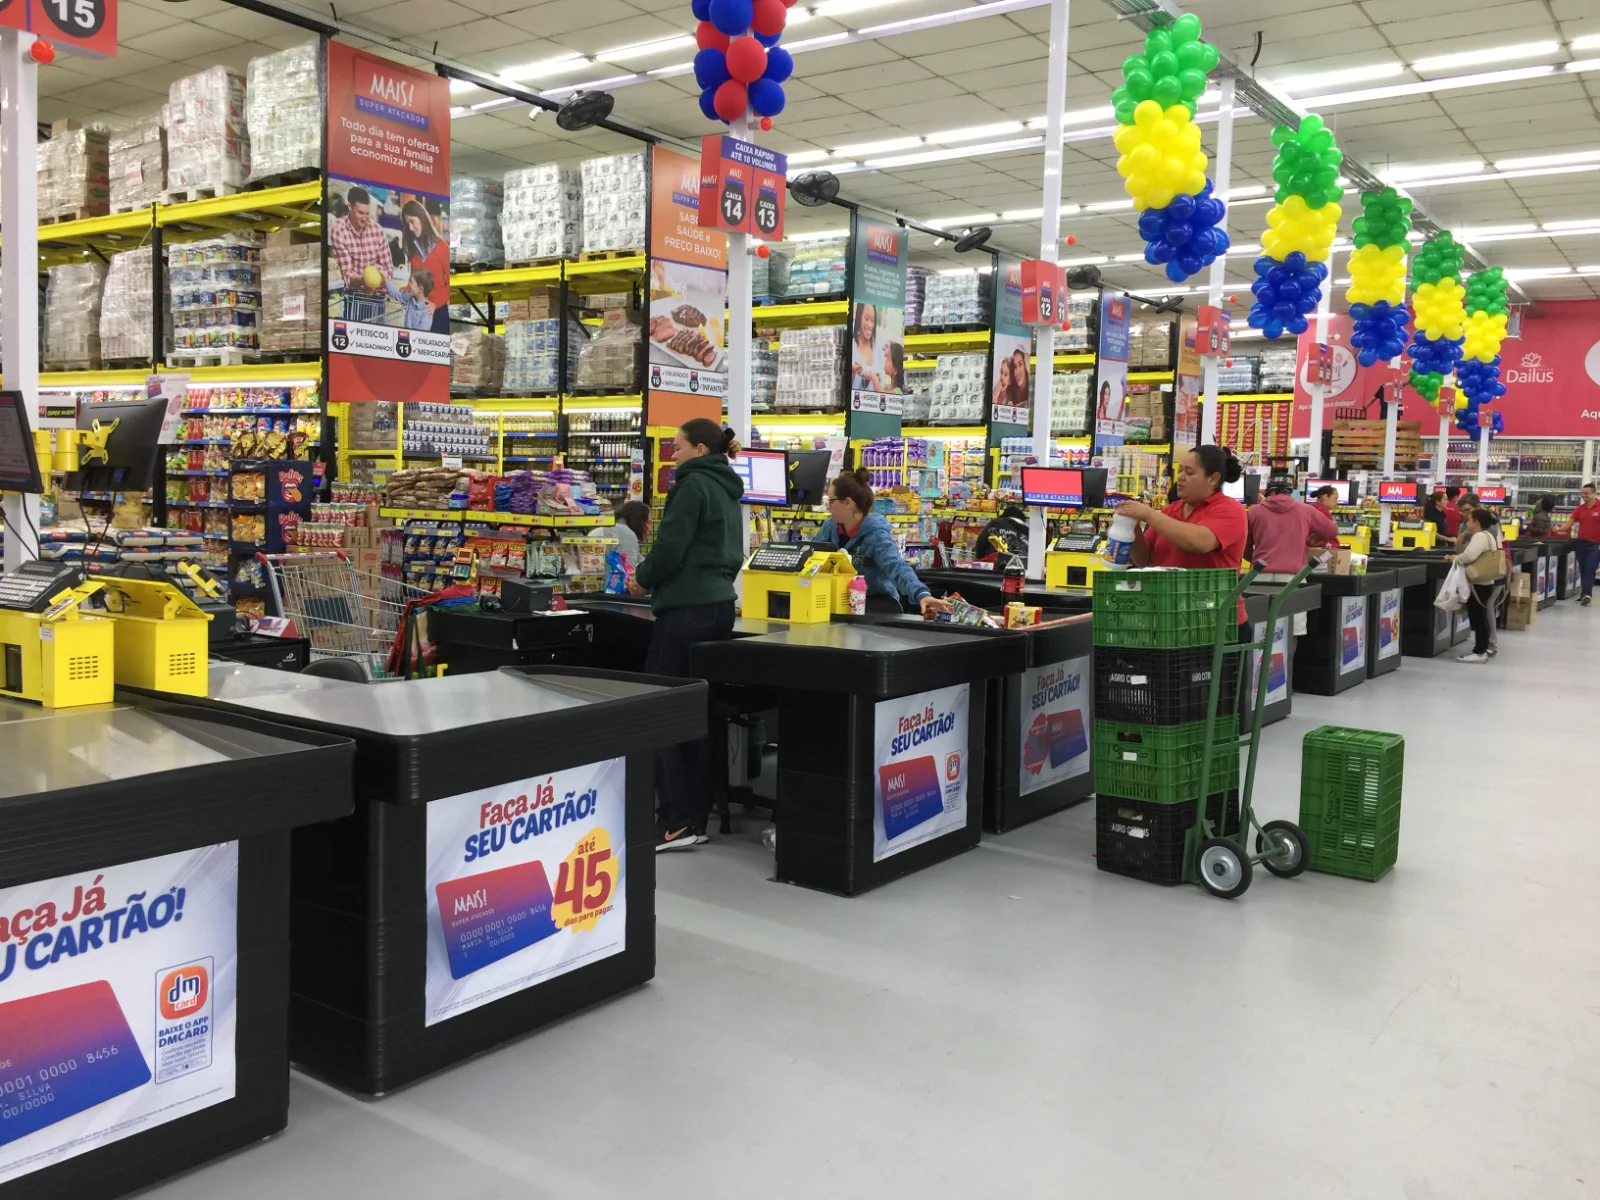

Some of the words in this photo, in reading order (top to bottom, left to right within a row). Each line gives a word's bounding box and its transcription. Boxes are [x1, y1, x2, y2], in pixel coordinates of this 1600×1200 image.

[52, 0, 95, 28] 15
[370, 74, 414, 107] MAIS!
[360, 99, 384, 111] SUPER
[388, 108, 425, 125] ATACADOS
[341, 117, 366, 132] Todo
[369, 127, 384, 137] dia
[387, 130, 404, 143] tem
[408, 138, 439, 153] ofertas
[350, 133, 372, 146] para
[384, 143, 400, 154] sua
[350, 146, 407, 168] economizar
[410, 160, 433, 174] Mais!
[731, 151, 742, 160] ATÉ
[752, 158, 776, 172] VOLUMES
[735, 143, 754, 155] CAIXA
[754, 147, 775, 161] RÁPIDO
[702, 175, 718, 184] MAIS!
[726, 191, 742, 201] CAIXA
[760, 201, 775, 210] CAIXA
[724, 200, 742, 220] 14
[759, 208, 775, 227] 13
[664, 237, 692, 251] PREÇO
[694, 244, 721, 258] BAIXO!
[705, 235, 711, 243] e
[873, 234, 893, 252] MAIS!
[1041, 303, 1051, 316] 12
[1059, 308, 1064, 321] 11
[333, 338, 346, 347] 12
[356, 328, 389, 339] PETISCOS
[355, 342, 392, 352] SALGADINHOS
[399, 346, 409, 354] 11
[418, 338, 450, 348] ENLATADOS
[1506, 368, 1554, 383] Dailus
[1387, 486, 1402, 495] MAI
[1482, 490, 1497, 498] MAIS
[1037, 670, 1051, 692] Faça
[1051, 664, 1064, 685] Já
[1110, 673, 1125, 683] AGRO
[1031, 687, 1045, 711] SEU
[1047, 673, 1081, 704] CARTÃO!
[898, 713, 921, 734] Faça
[922, 702, 934, 723] Já
[891, 728, 911, 756] SEU
[912, 712, 955, 746] CARTÃO!
[888, 773, 905, 791] MAIS!
[479, 792, 528, 828] Faça
[530, 776, 554, 811] Já
[464, 823, 506, 863] SEU
[510, 789, 597, 844] CARTÃO!
[1112, 823, 1126, 833] AGRO
[578, 837, 596, 854] até
[554, 848, 611, 914] 45
[61, 874, 107, 924] Já
[454, 889, 487, 915] MAIS!
[471, 908, 495, 920] ATACADOS
[564, 916, 578, 927] dias
[578, 911, 594, 925] para
[594, 904, 615, 921] pagar.
[24, 886, 187, 972] CARTÃO!
[460, 927, 484, 943] 0000
[485, 919, 505, 933] 0001
[507, 912, 526, 924] 0000
[169, 975, 200, 1002] dm
[175, 995, 196, 1010] card
[159, 1024, 183, 1037] BAIXE
[185, 1021, 191, 1029] O
[193, 1016, 209, 1027] APP
[159, 1025, 208, 1048] DMCARD
[40, 1059, 77, 1081] 0000
[86, 1045, 119, 1064] 8456
[18, 1082, 52, 1101] SILVA
[3, 1093, 55, 1119] 00/0000
